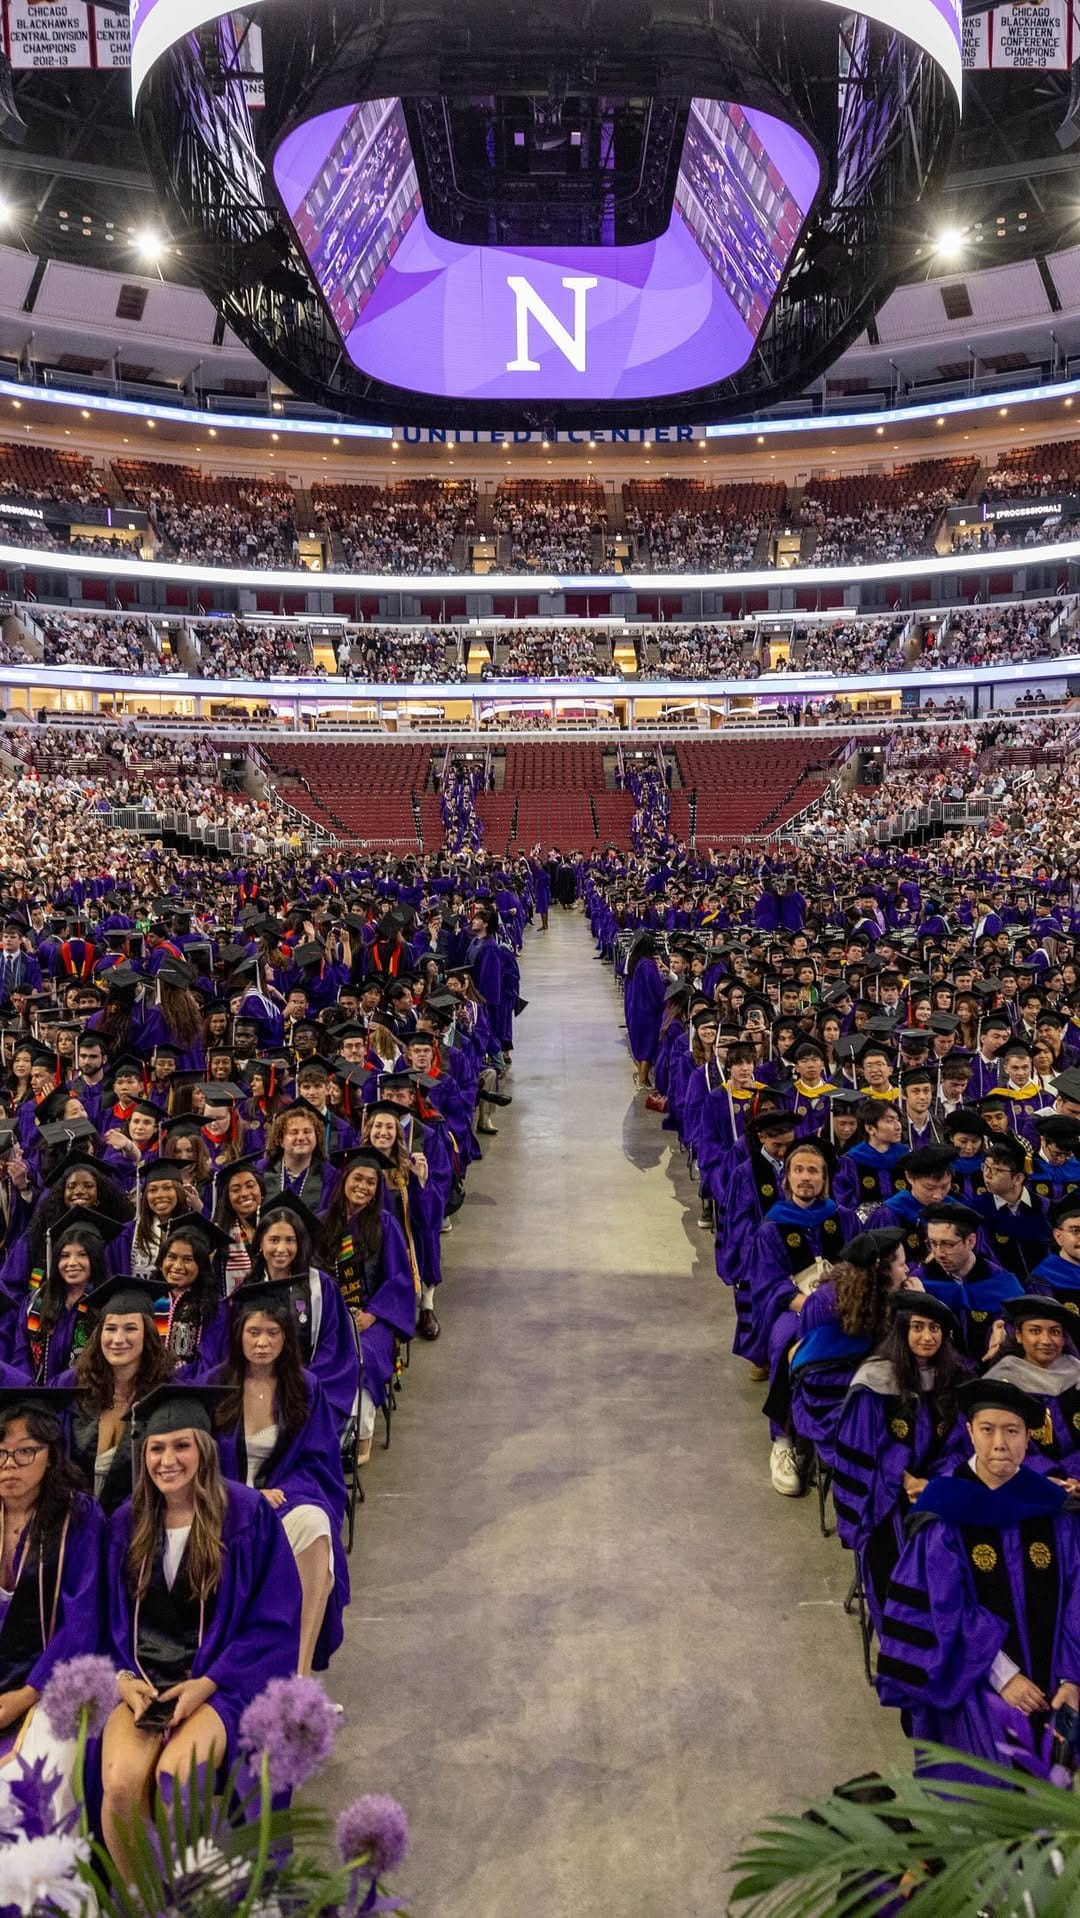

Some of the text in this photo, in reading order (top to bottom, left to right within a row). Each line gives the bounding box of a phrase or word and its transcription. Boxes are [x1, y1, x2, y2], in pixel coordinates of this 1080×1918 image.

[28, 7, 67, 17] CHICAGO
[1012, 7, 1050, 17] CHICAGO
[17, 19, 80, 29] BLACKHAWKS
[1001, 17, 1061, 27] BLACKHAWKS
[11, 31, 88, 41] CENTRAL DIVISION
[1008, 28, 1053, 37] WESTERN
[1000, 37, 1060, 47] CONFERENCE
[23, 43, 76, 54] CHAMPIONS
[1005, 47, 1055, 57] CHAMPIONS
[33, 56, 68, 66] 2012-13
[1013, 57, 1047, 67] 2012-13
[506, 276, 598, 372] N
[403, 425, 694, 444] UNITED CENTER
